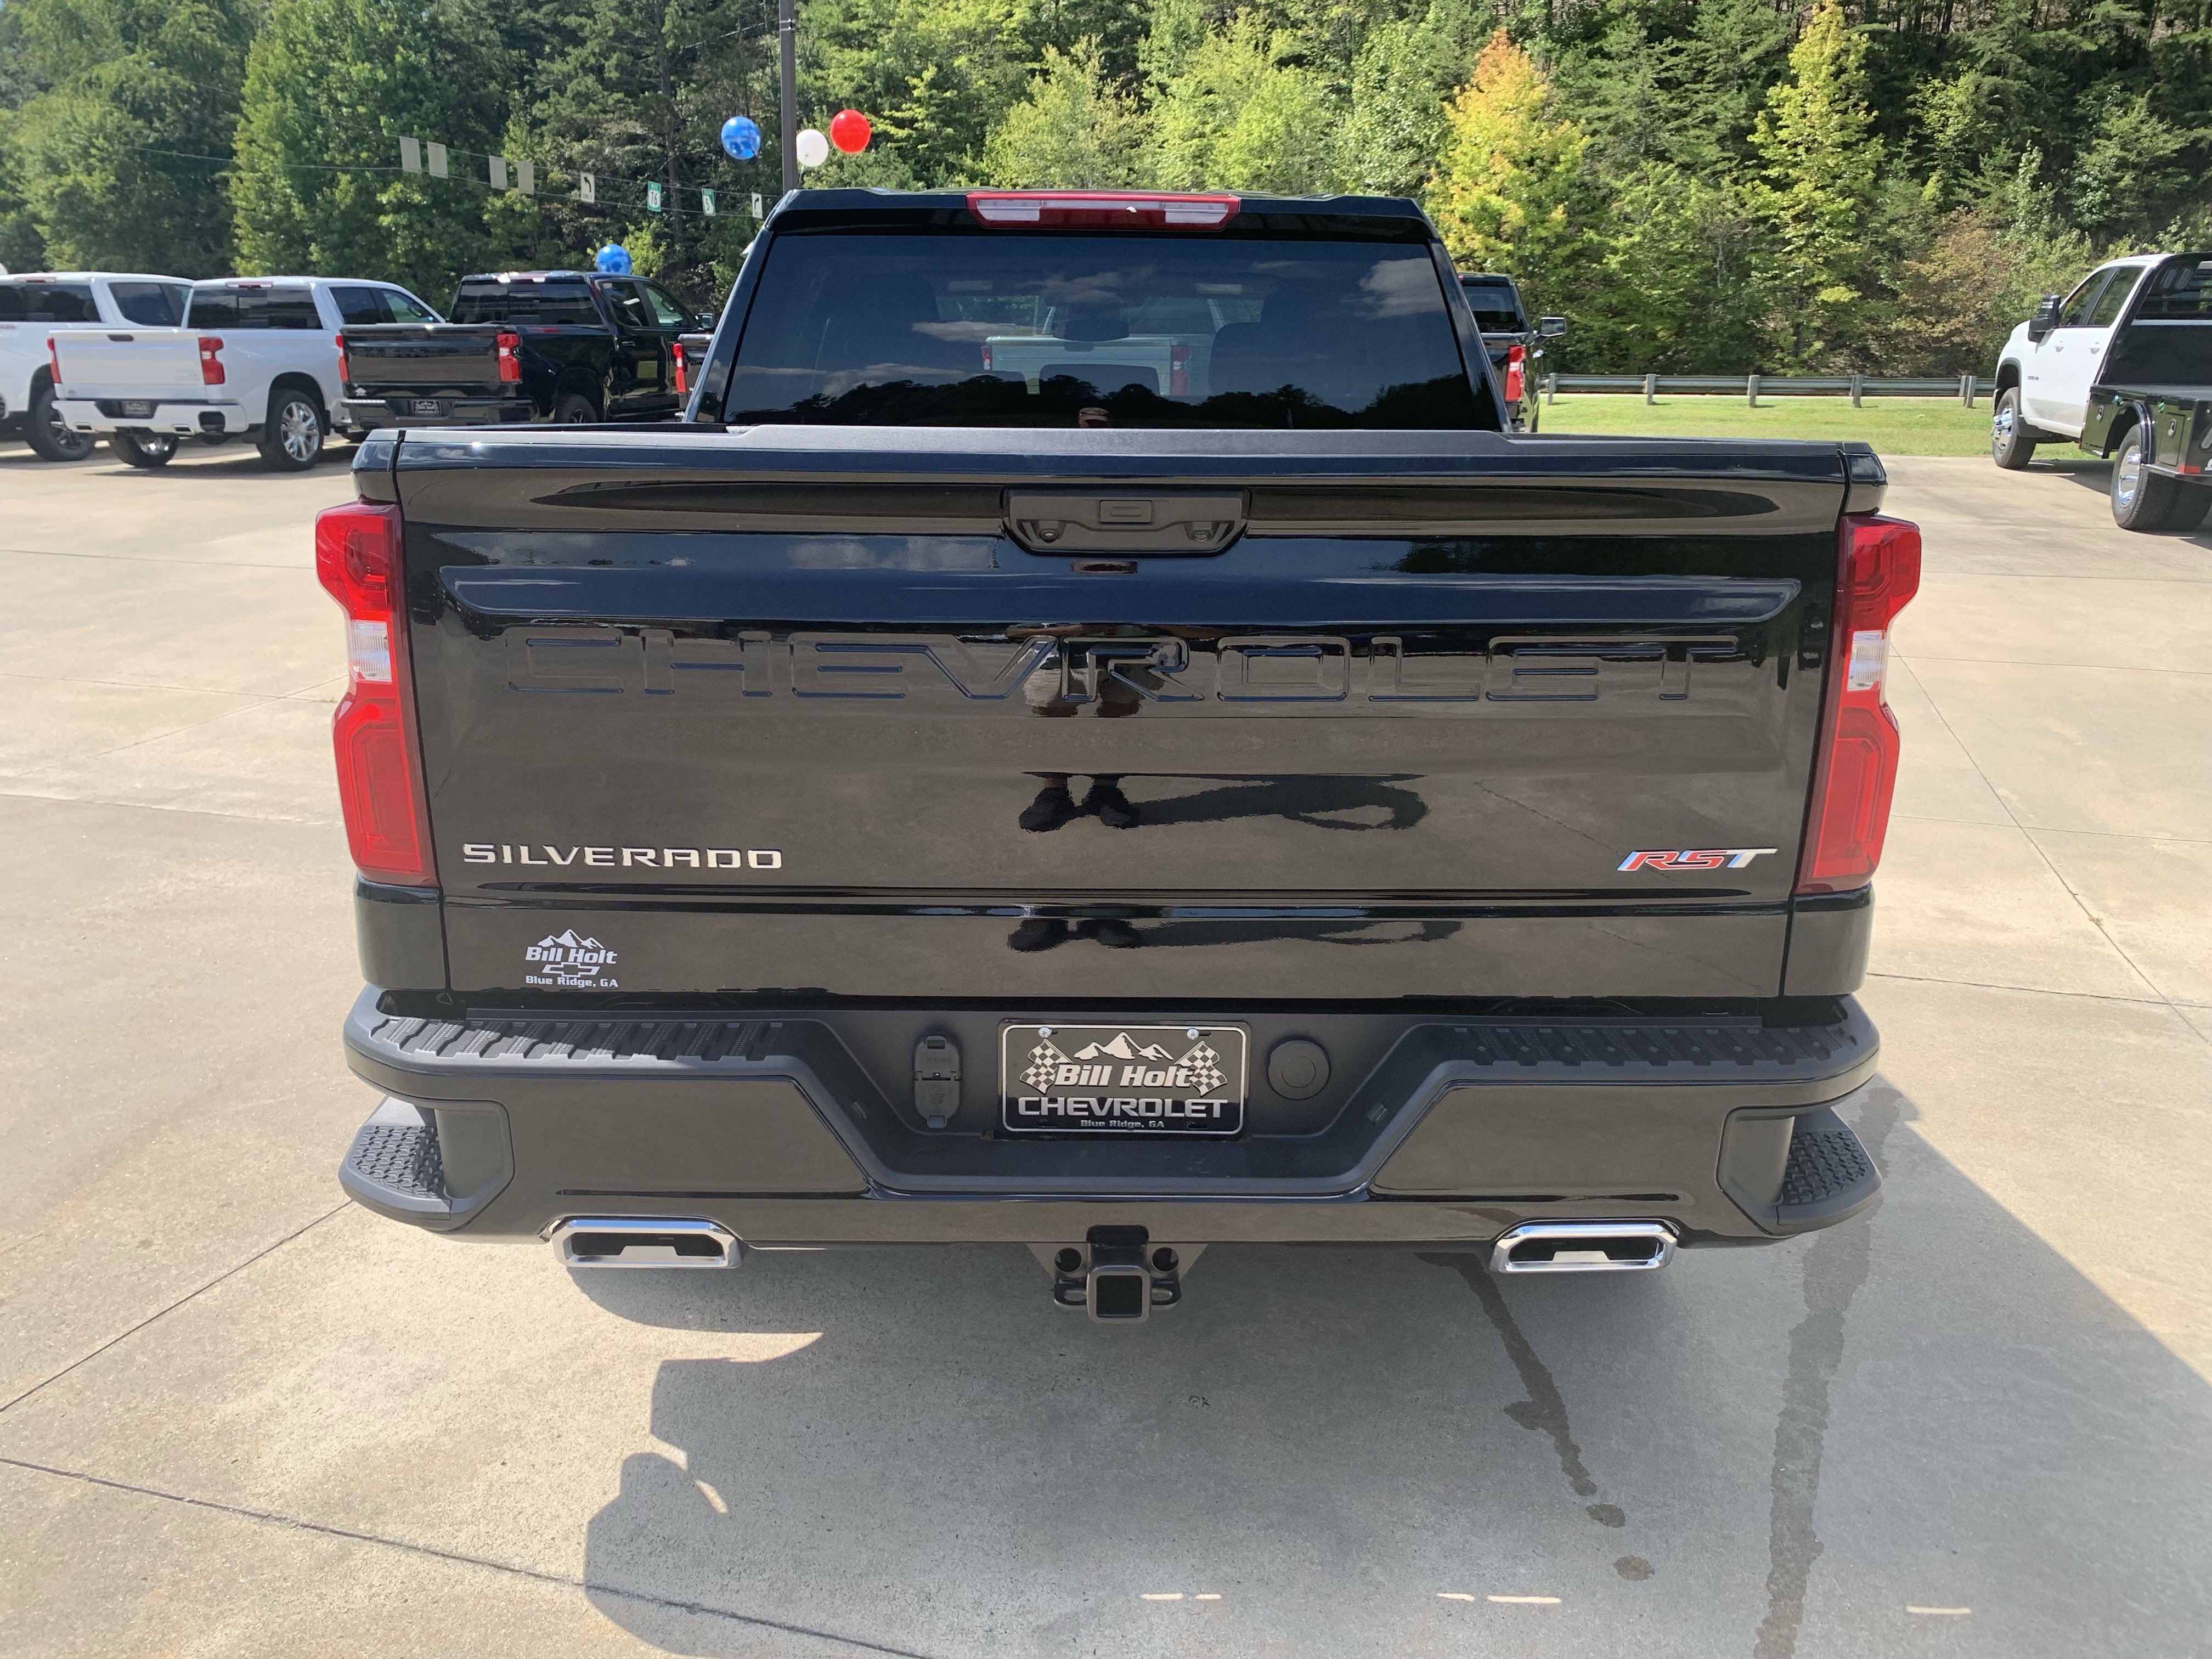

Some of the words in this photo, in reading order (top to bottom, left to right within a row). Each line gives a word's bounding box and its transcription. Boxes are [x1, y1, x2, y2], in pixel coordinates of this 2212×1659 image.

[651, 191, 658, 205] 76
[706, 198, 709, 211] 5
[504, 627, 1738, 702] CHEVROLET
[463, 843, 782, 869] SILVERADO
[1617, 848, 1778, 871] RST
[525, 946, 563, 962] Bill
[568, 948, 618, 964] Holt
[525, 975, 553, 985] Blue
[557, 976, 596, 988] Ridge,
[600, 978, 618, 988] GA
[1054, 1064, 1113, 1086] Bill
[1119, 1065, 1194, 1088] Holt
[1018, 1096, 1228, 1118] CHEVROLET
[1080, 1119, 1105, 1128] Blue
[1109, 1120, 1144, 1129] Ridge,
[1148, 1120, 1165, 1128] GA
